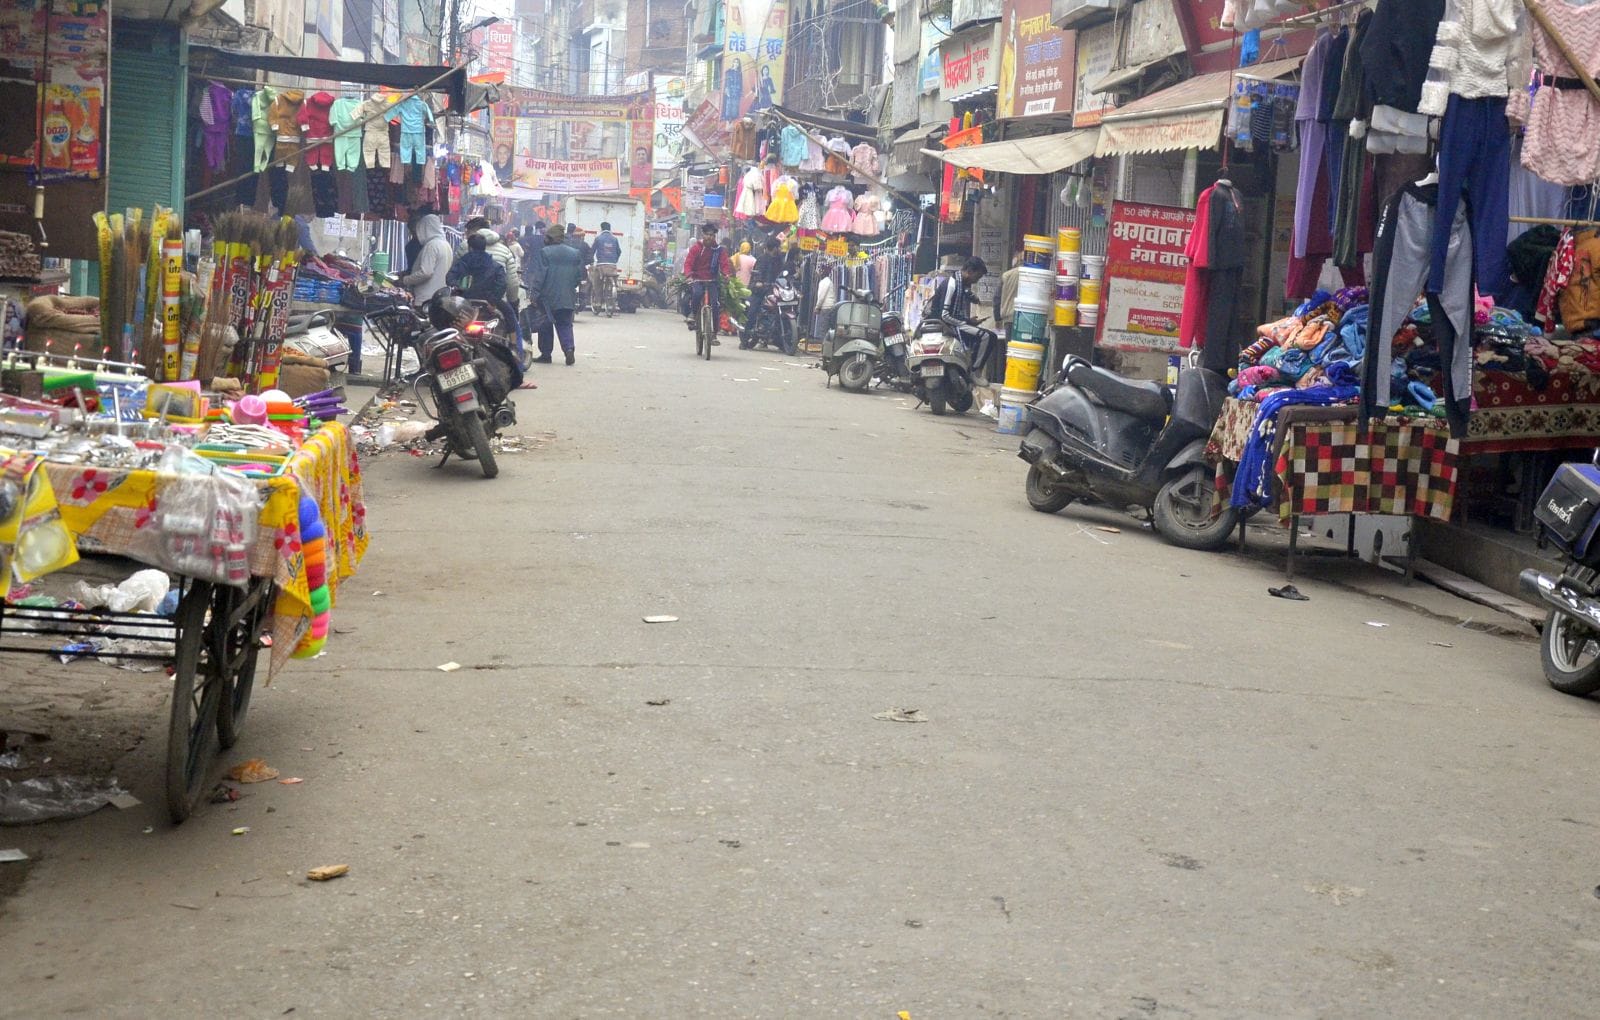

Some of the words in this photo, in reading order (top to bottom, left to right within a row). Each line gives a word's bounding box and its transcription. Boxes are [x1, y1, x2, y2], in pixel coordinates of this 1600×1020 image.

[490, 30, 512, 44] शिप्रा
[548, 161, 569, 172] मन्दिर
[571, 162, 586, 172] प्राण
[588, 160, 613, 171] प्रतिष्ठा
[1123, 207, 1136, 216] 150
[1152, 209, 1160, 219] से
[1160, 210, 1185, 222] आपकी
[1113, 221, 1185, 247] भगवान
[1130, 244, 1159, 265] रंग
[1132, 313, 1170, 322] asianpaints
